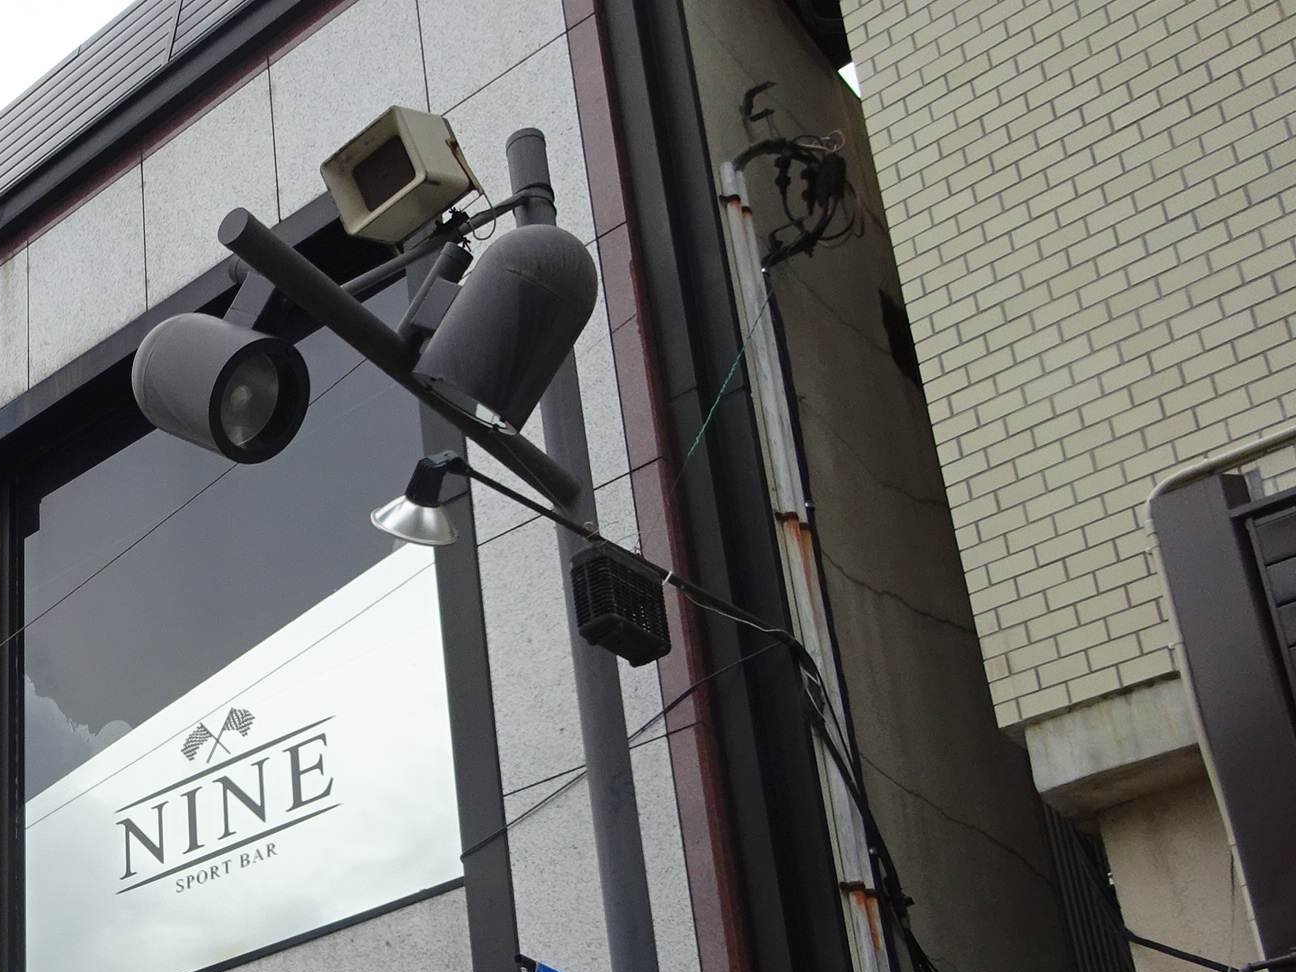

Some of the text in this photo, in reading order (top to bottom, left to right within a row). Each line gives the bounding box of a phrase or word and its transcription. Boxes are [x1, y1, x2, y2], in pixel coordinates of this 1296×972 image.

[115, 733, 334, 880] NINE
[175, 842, 278, 893] SPORT BAR
